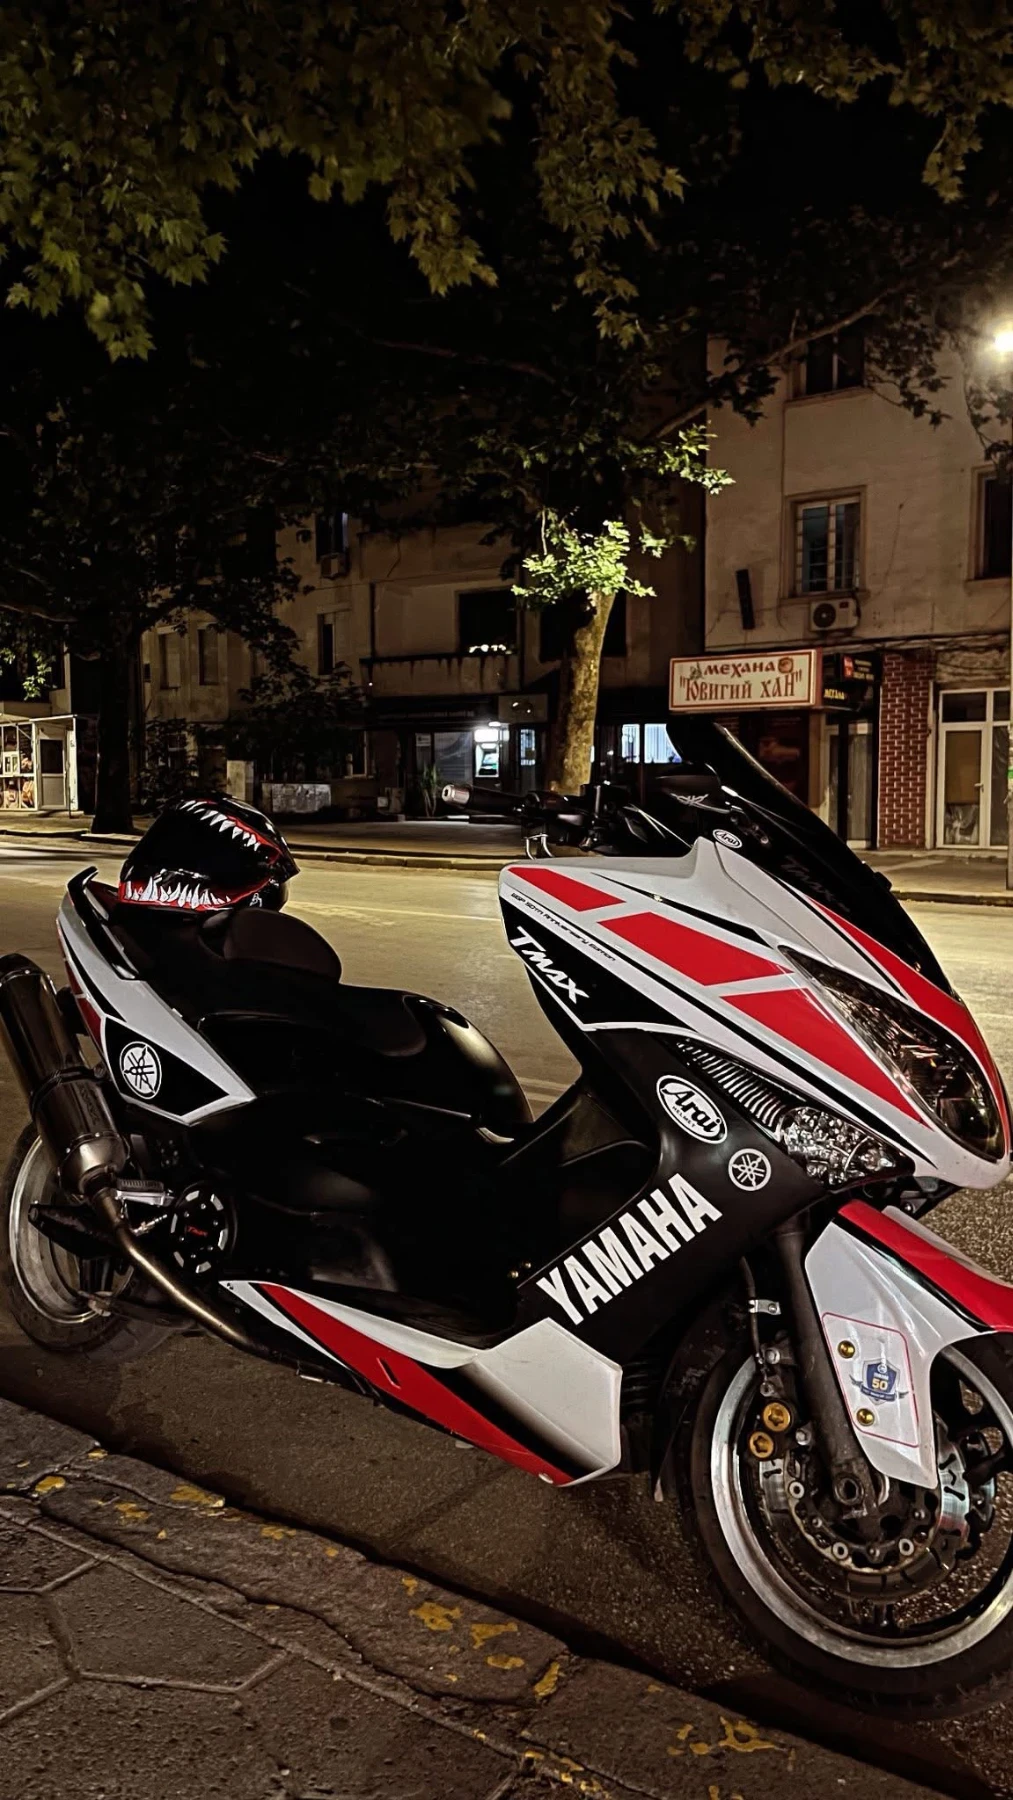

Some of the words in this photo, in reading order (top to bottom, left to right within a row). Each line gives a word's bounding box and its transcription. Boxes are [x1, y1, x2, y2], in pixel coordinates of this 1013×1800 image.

[510, 925, 590, 1004] TMAX
[661, 1086, 720, 1133] Arai
[671, 1105, 697, 1128] HELMET
[536, 1173, 723, 1326] YAMAHA
[871, 1378, 888, 1390] 50
